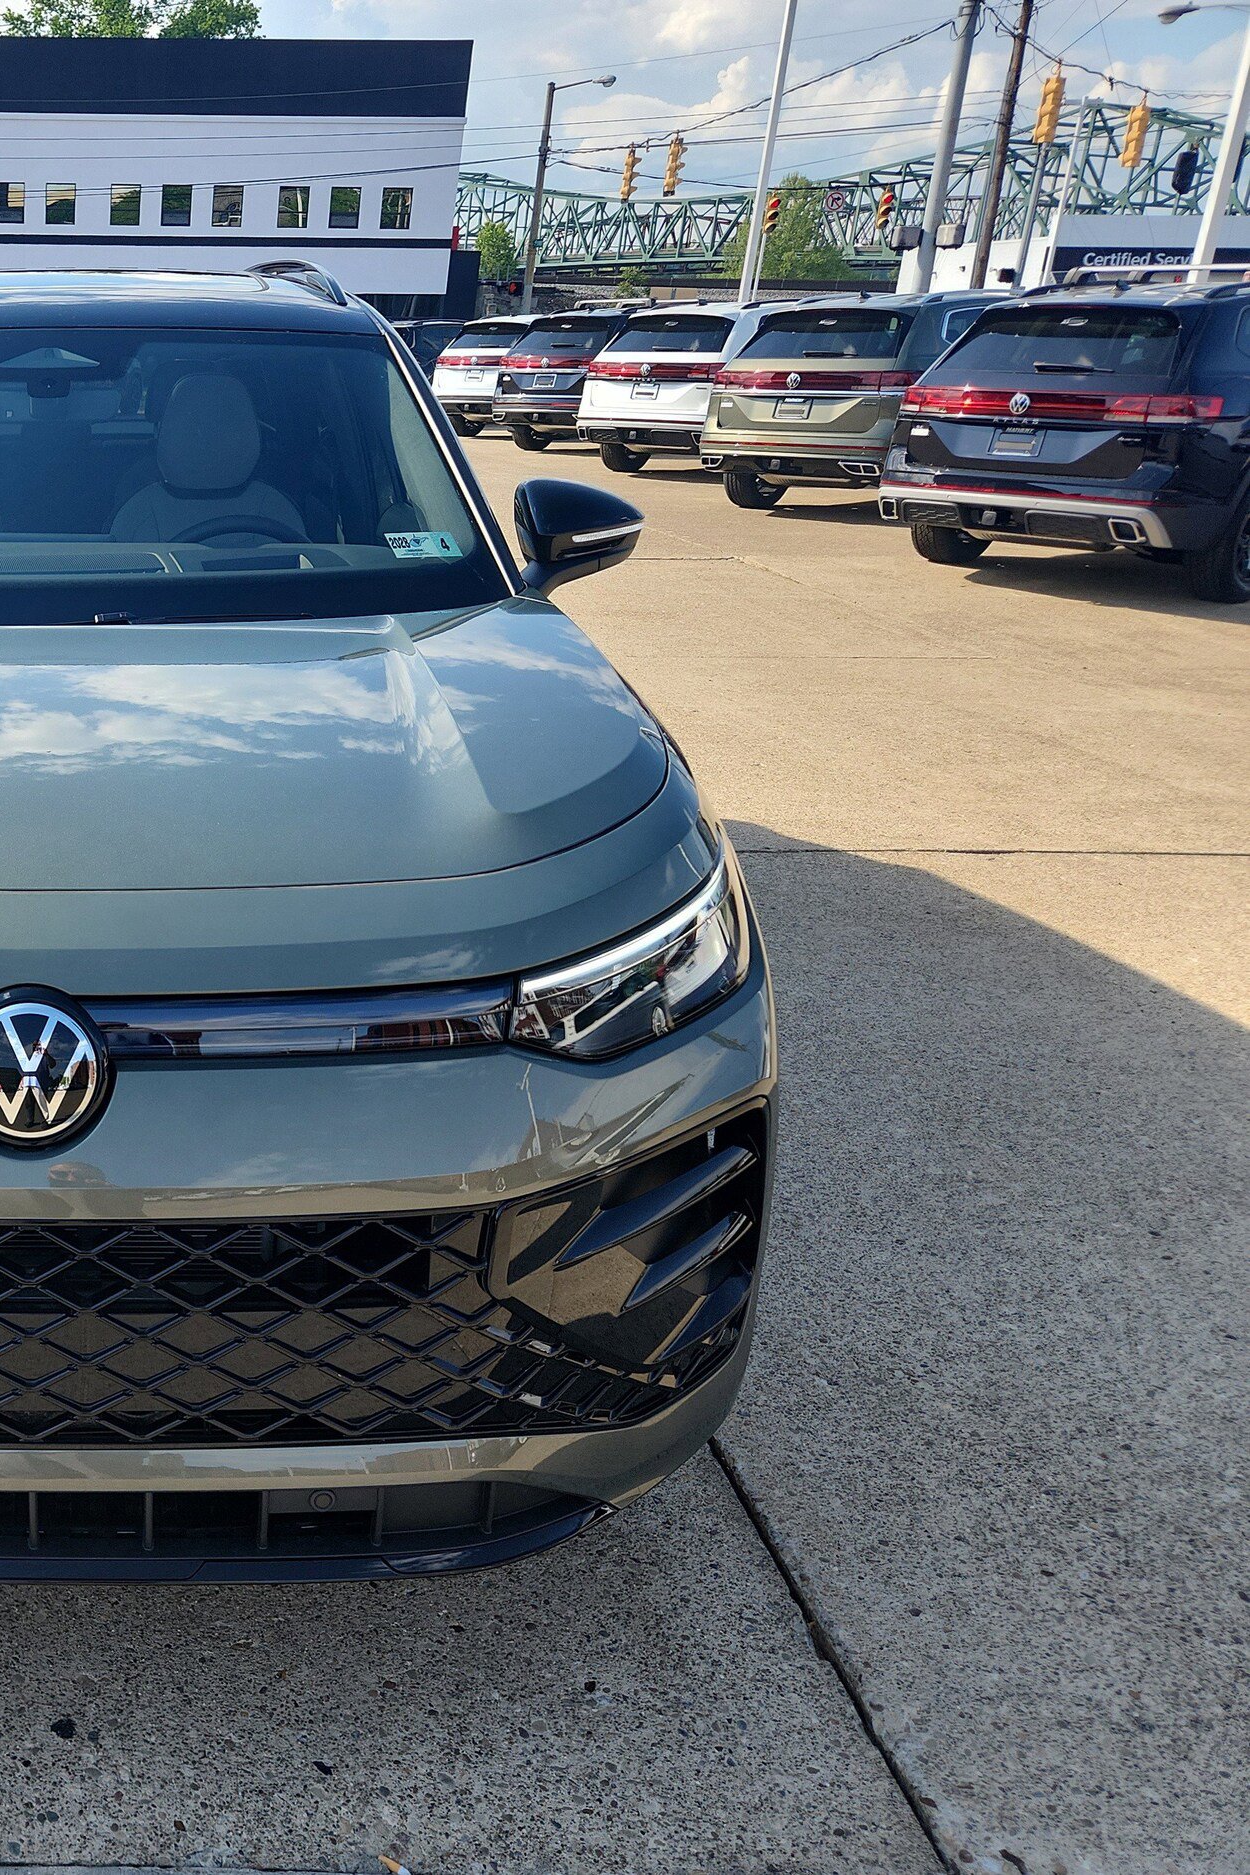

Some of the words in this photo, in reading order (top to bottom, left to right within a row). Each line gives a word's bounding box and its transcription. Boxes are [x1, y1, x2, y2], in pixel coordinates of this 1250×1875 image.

[1083, 252, 1151, 266] Certified
[388, 536, 411, 549] 2028
[440, 537, 451, 551] 4
